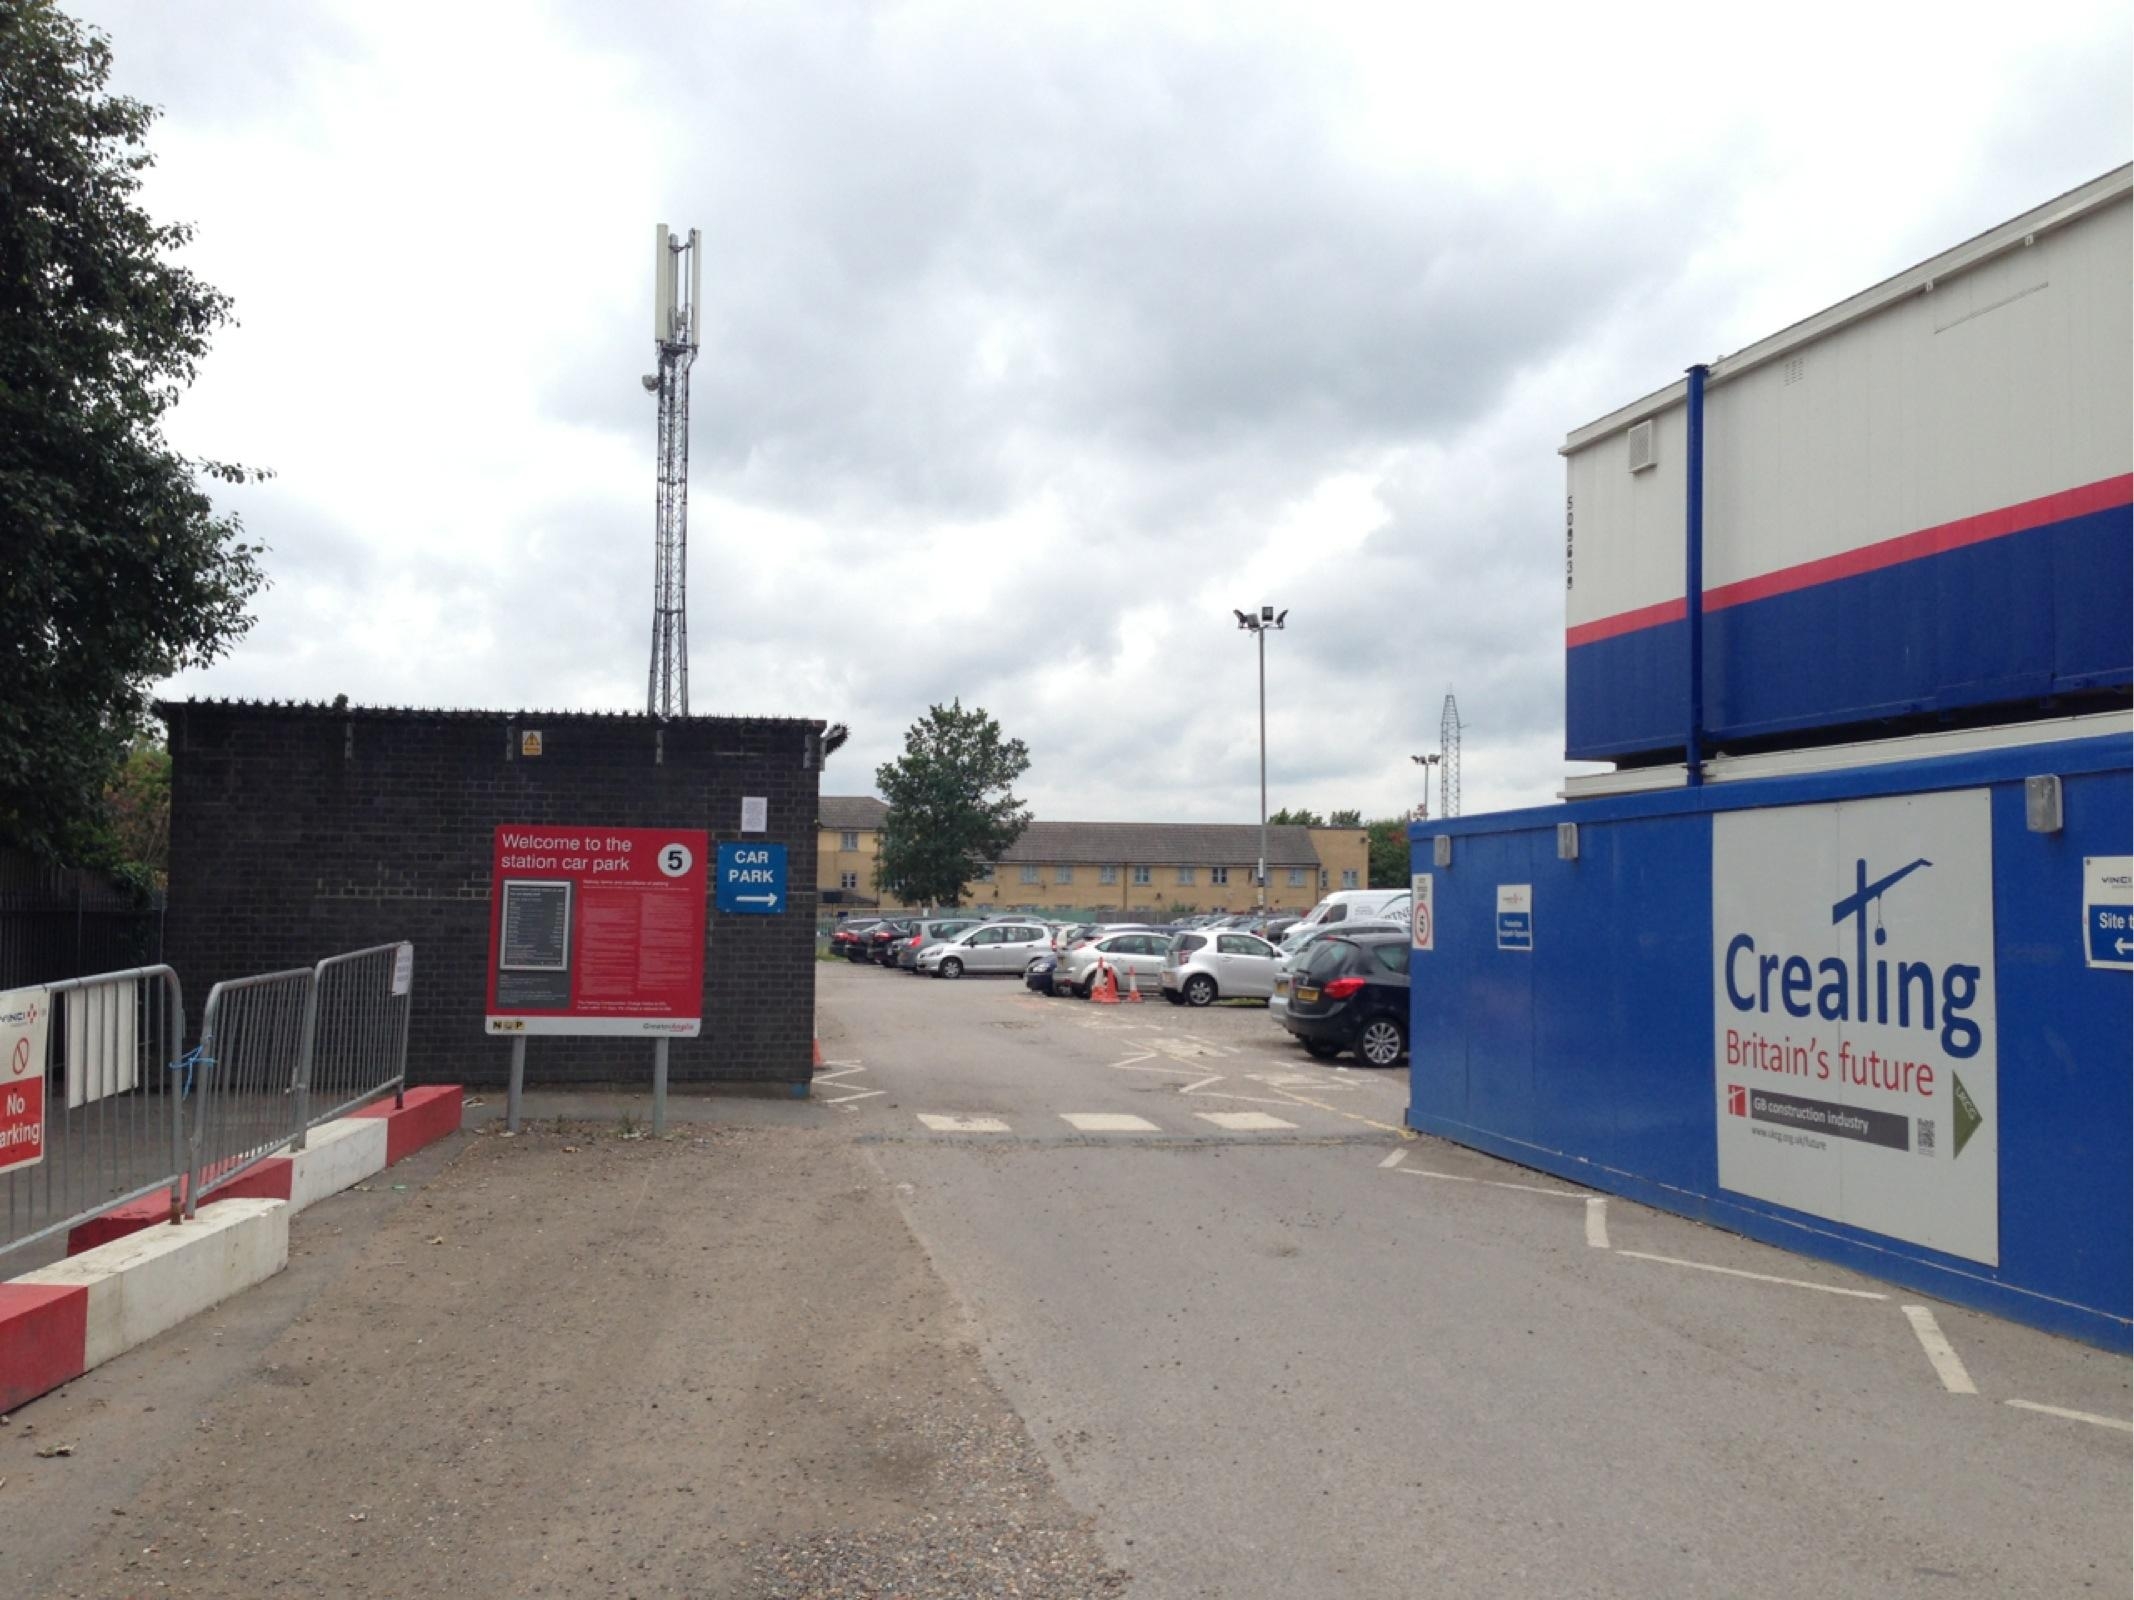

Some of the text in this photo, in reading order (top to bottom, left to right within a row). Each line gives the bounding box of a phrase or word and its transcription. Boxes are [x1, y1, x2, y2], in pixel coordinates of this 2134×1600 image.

[502, 833, 632, 852] Welcome to the
[501, 854, 630, 874] station car park
[668, 850, 683, 870] 5
[735, 850, 768, 864] CAR
[728, 869, 774, 883] PARK
[2099, 911, 2126, 929] Site
[1726, 1029, 1934, 1096] Britain's future
[6, 1093, 25, 1117] No
[1753, 1096, 1870, 1135] GB construction industry
